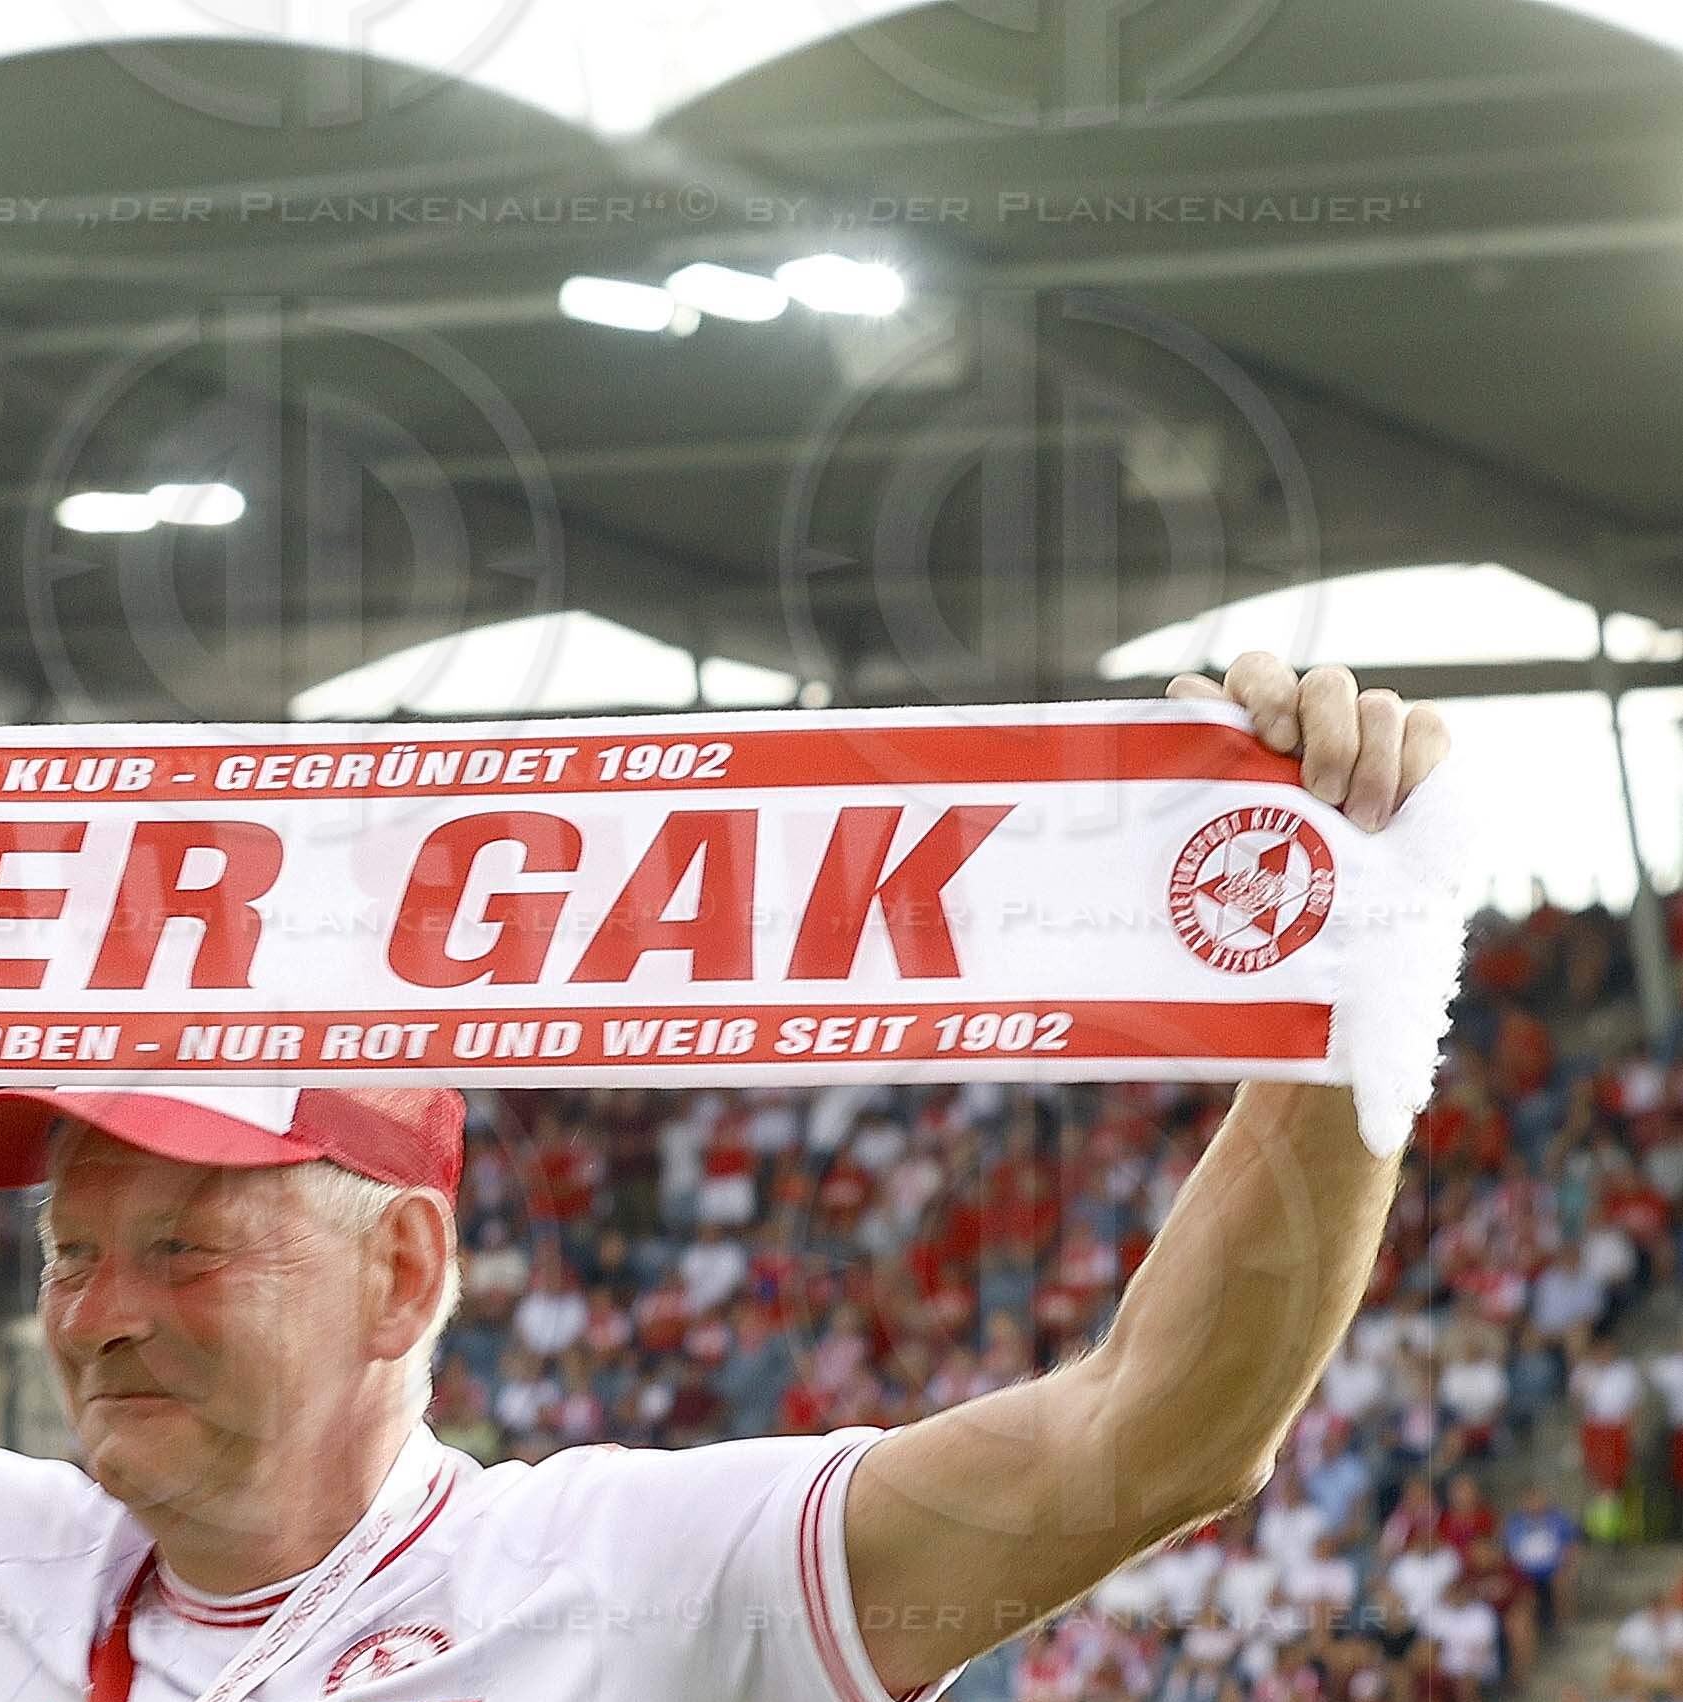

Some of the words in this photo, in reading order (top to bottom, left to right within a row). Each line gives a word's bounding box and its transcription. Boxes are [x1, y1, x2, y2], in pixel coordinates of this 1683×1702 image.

[1, 755, 158, 793] KLUB
[213, 744, 580, 791] GEGRÜNDET
[596, 741, 735, 782] 1902
[383, 803, 1023, 990] GAK
[175, 1025, 303, 1062] NUR
[318, 1022, 439, 1062] ROT
[452, 1019, 584, 1059] UND
[600, 1016, 755, 1058] WEIß
[772, 1014, 918, 1055] SEIT
[932, 1010, 1076, 1053] 1902
